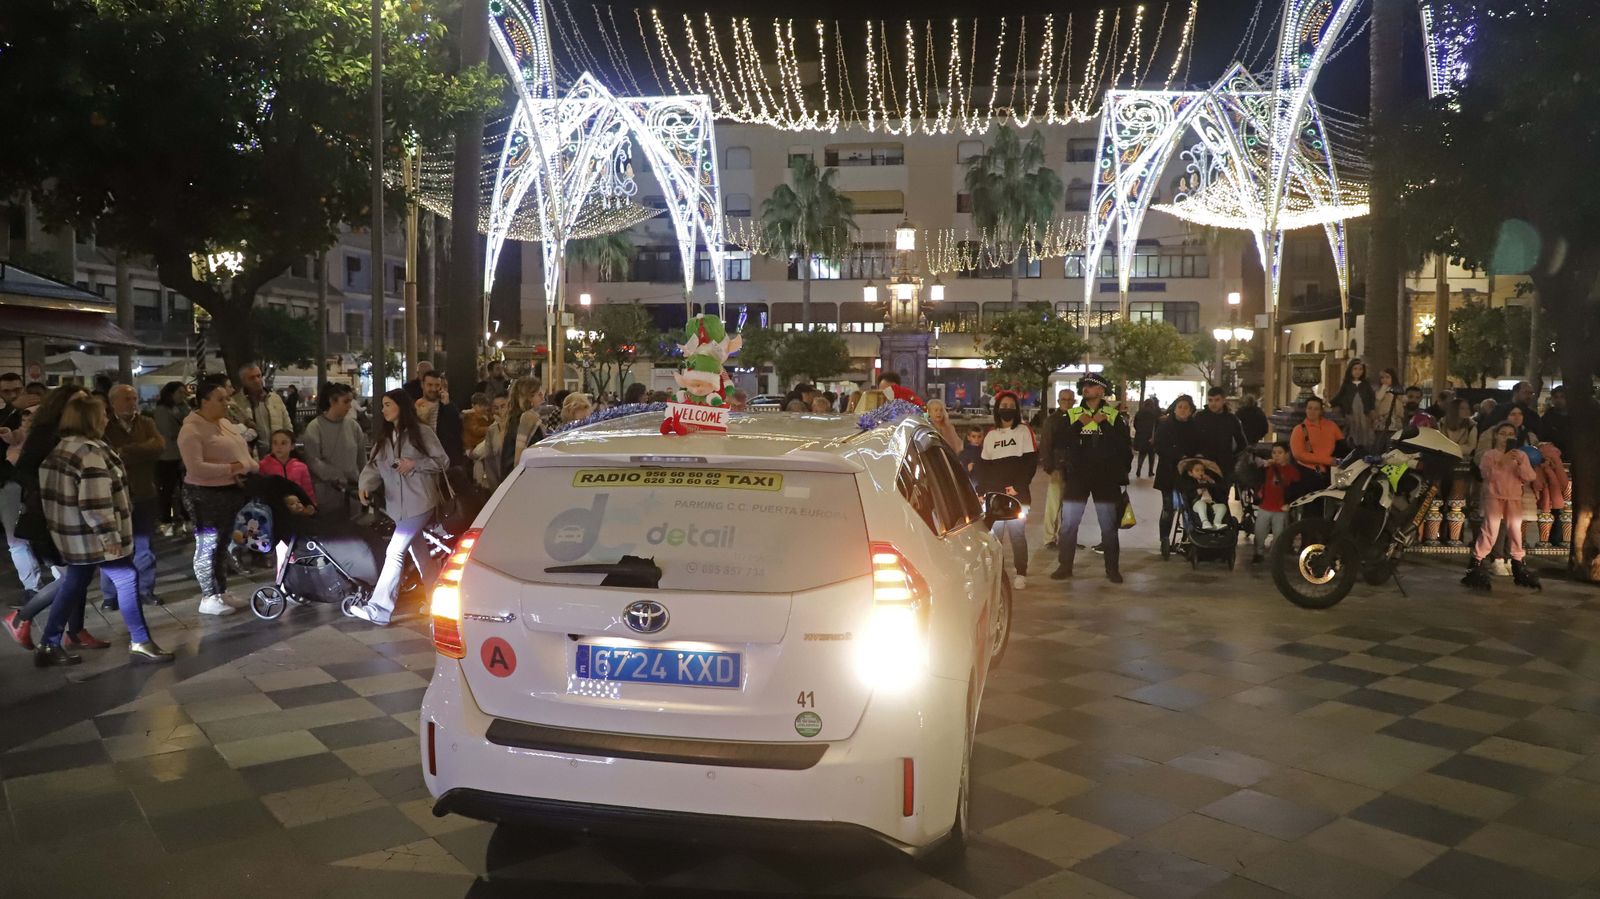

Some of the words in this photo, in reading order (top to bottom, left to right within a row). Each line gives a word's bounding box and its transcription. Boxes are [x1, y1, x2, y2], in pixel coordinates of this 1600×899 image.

[673, 406, 723, 424] WELCOME
[993, 438, 1017, 449] FILA
[580, 473, 641, 483] RADIO
[726, 475, 775, 487] TAXI
[674, 499, 724, 511] PARKING
[752, 503, 797, 516] PUERTA
[646, 522, 736, 549] detail
[488, 645, 510, 671] A
[594, 649, 667, 680] 6724
[677, 653, 734, 684] KXD
[579, 664, 587, 674] E
[796, 690, 815, 708] 41
